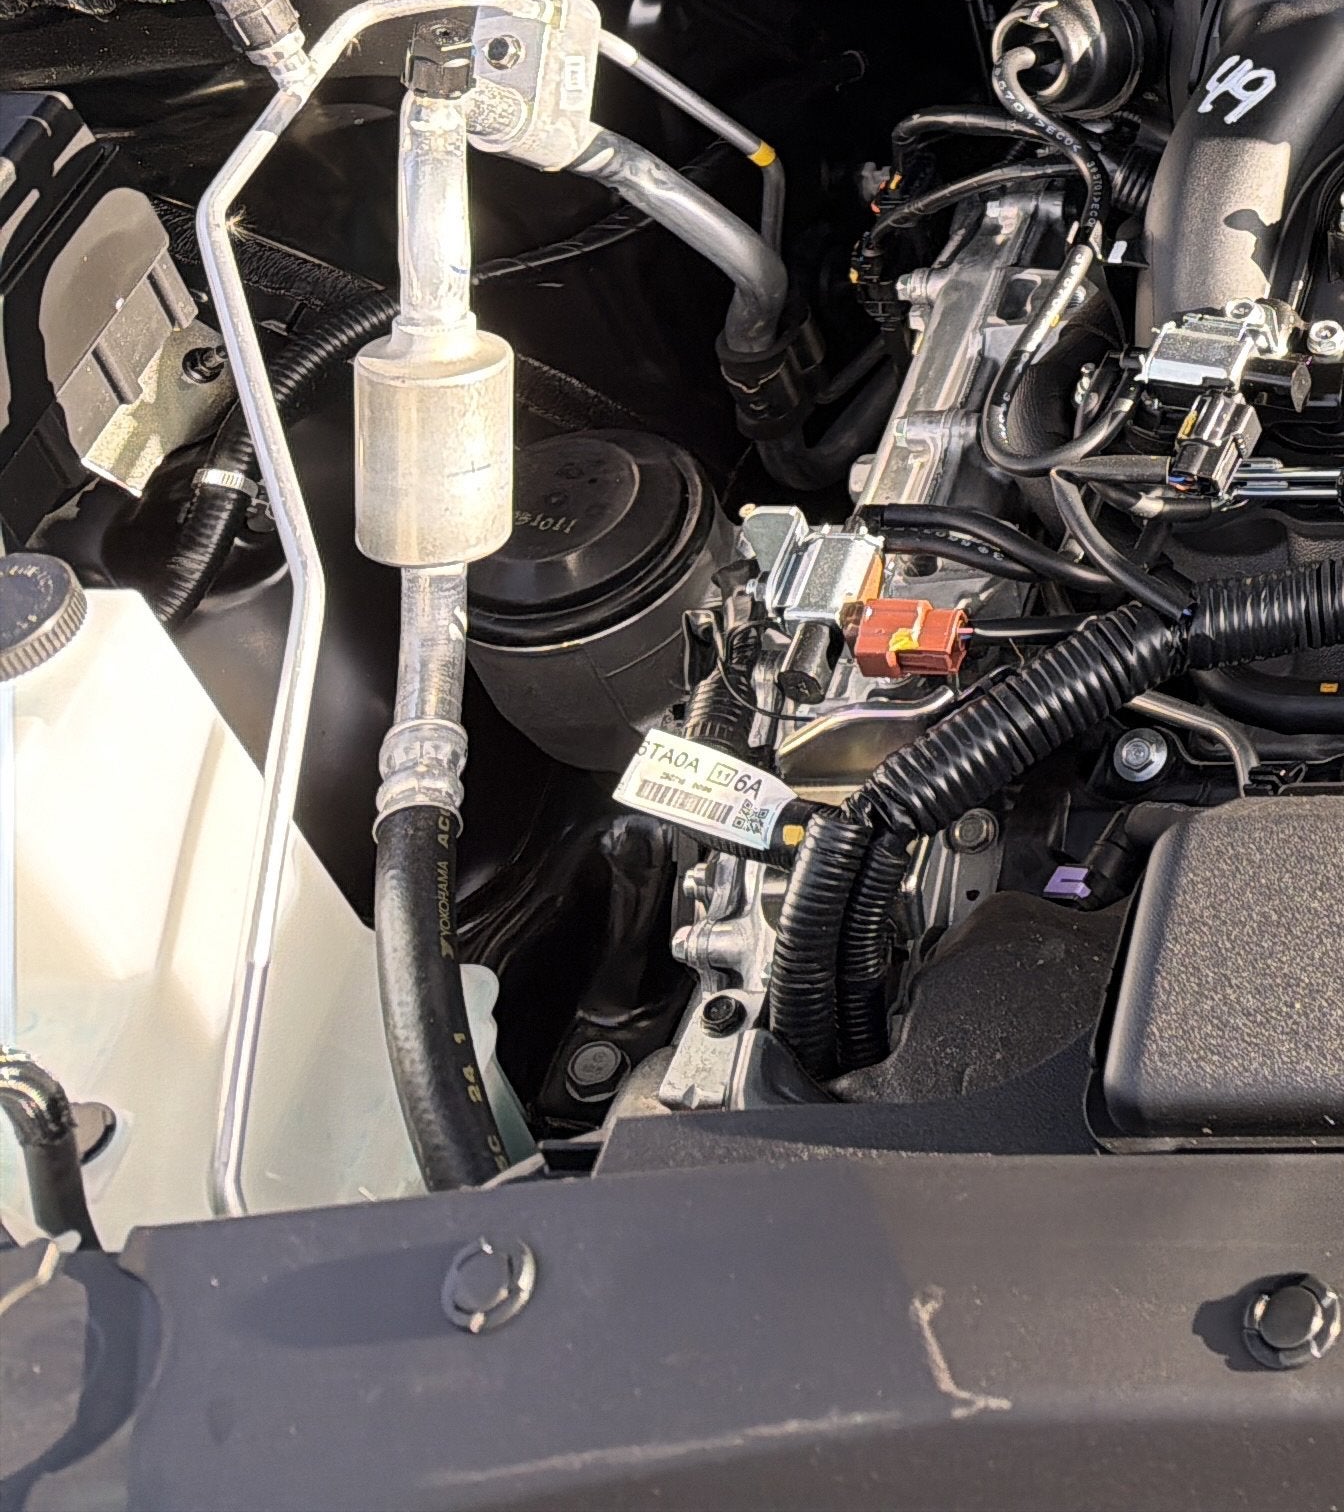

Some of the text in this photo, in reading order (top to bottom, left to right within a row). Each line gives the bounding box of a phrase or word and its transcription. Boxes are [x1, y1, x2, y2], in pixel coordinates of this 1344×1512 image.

[1197, 54, 1277, 125] 49
[734, 774, 764, 800] 6A
[436, 861, 453, 936] YOKOHAMA
